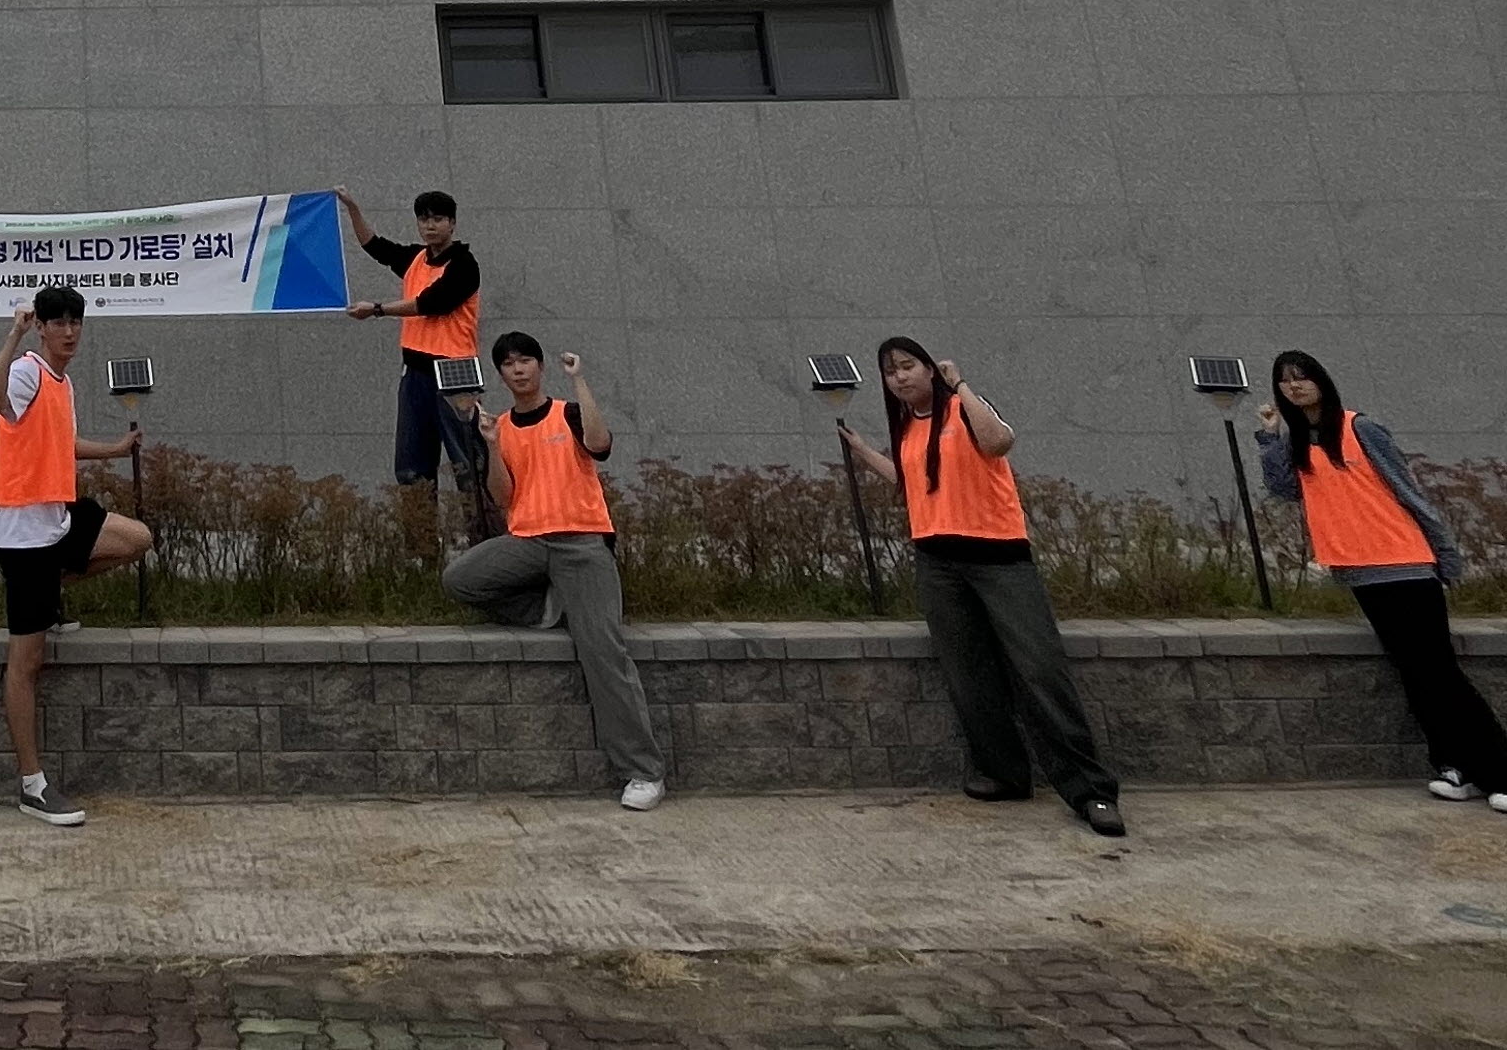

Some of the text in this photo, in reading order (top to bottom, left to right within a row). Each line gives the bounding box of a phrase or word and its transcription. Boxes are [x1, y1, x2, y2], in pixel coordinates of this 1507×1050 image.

[13, 239, 54, 263] 개선
[192, 232, 234, 259] 설치
[139, 271, 179, 287] 봉사단
